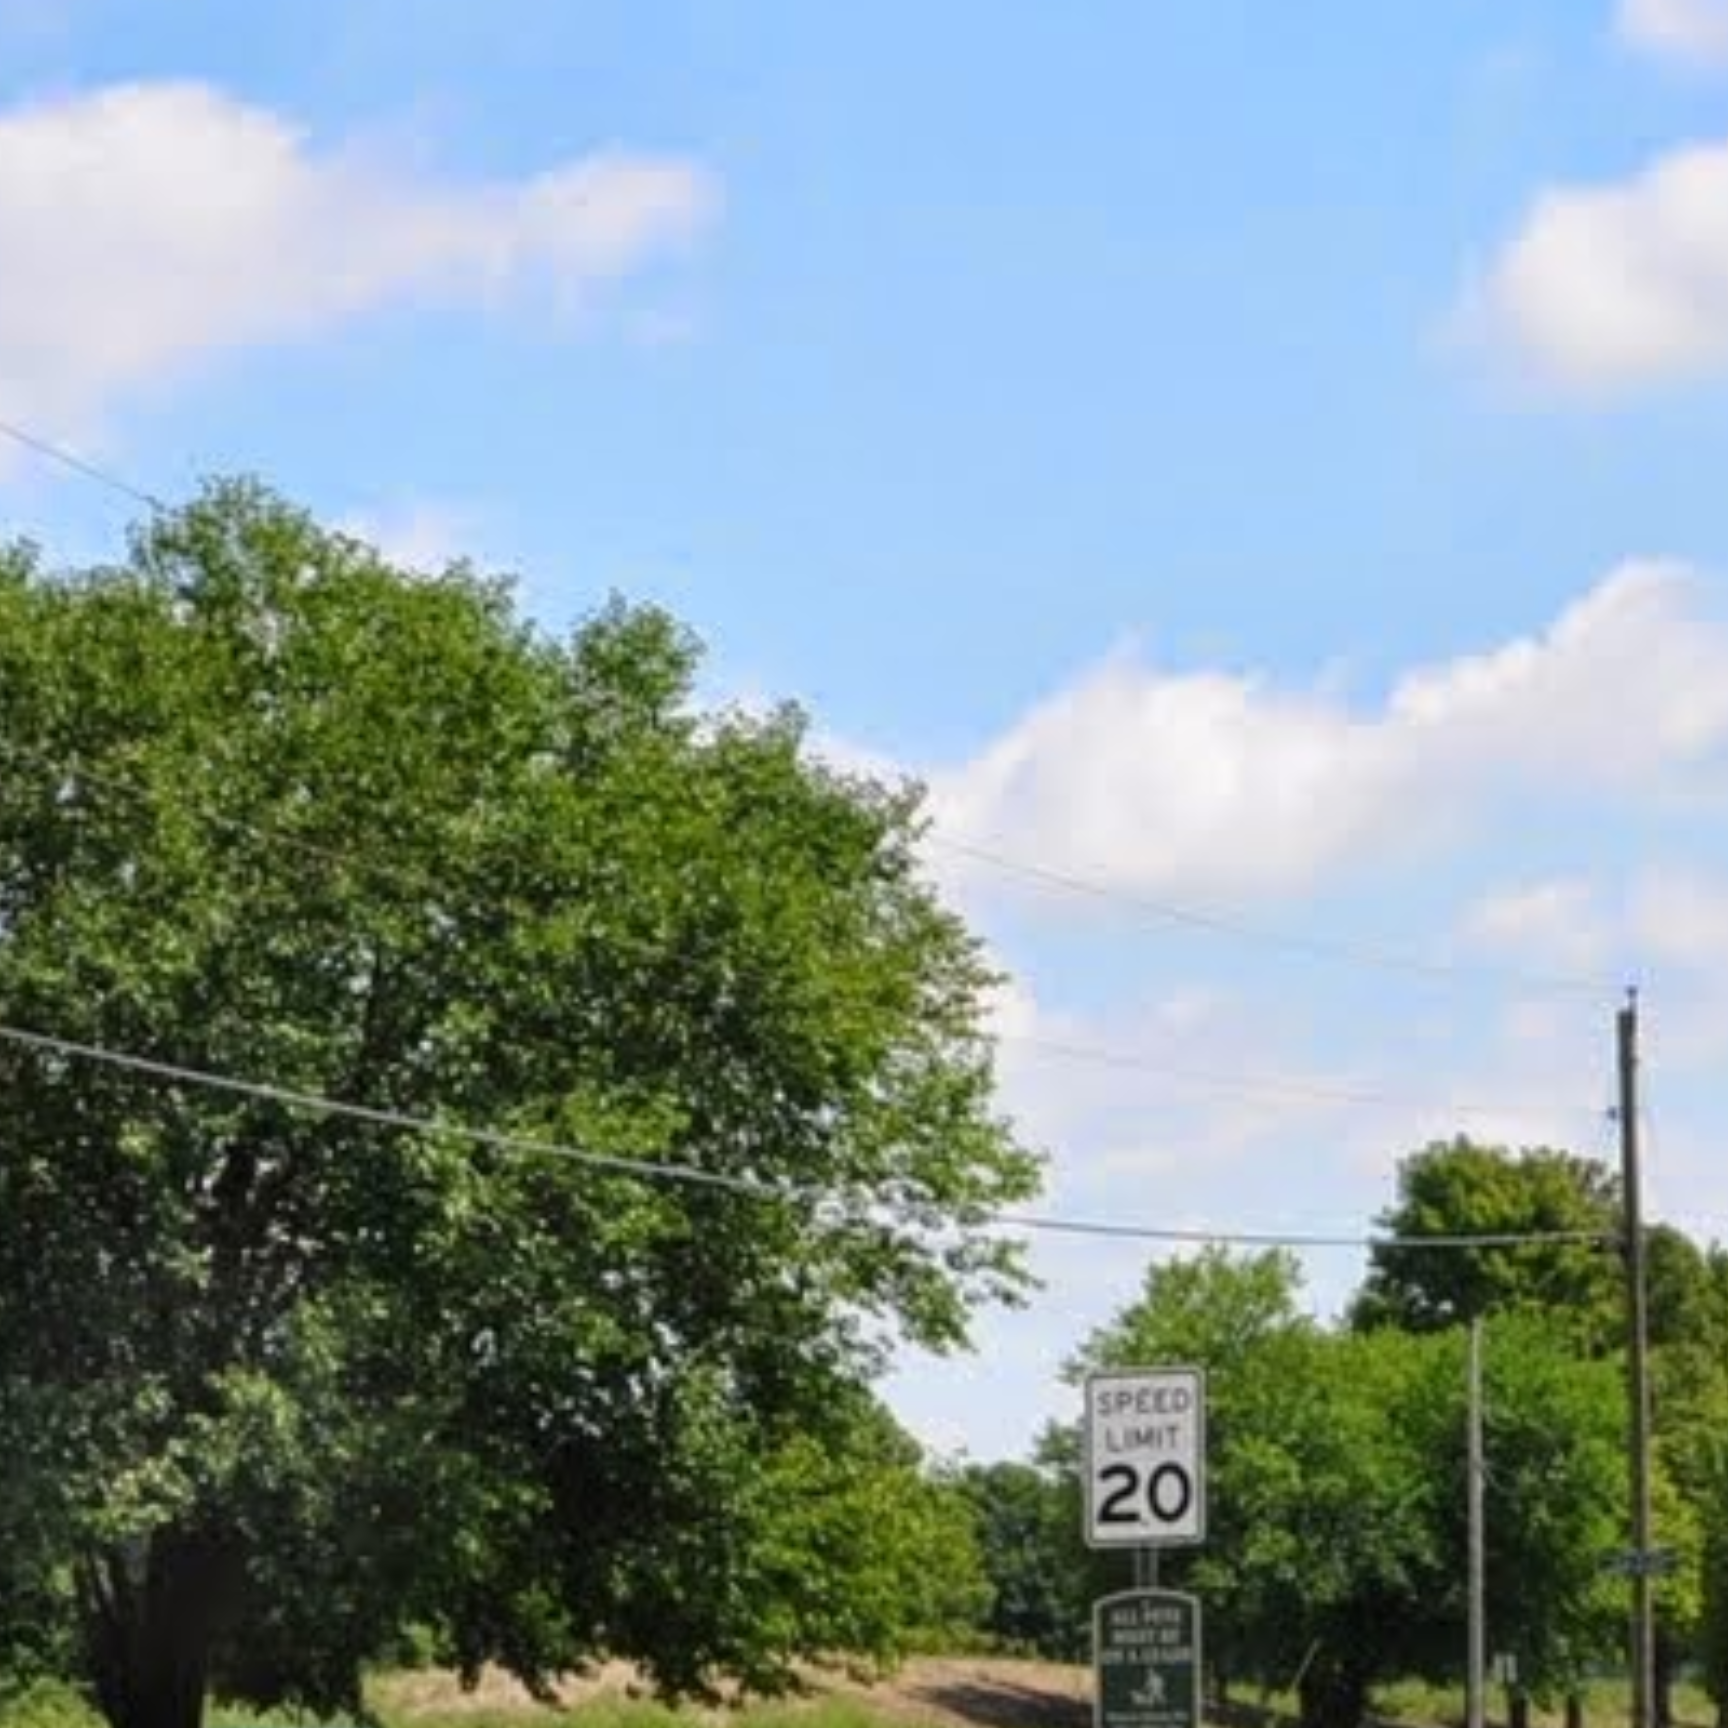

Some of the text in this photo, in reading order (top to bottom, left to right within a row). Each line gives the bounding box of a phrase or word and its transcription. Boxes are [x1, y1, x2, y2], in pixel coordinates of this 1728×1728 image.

[1097, 1386, 1191, 1418] SPEED
[1105, 1424, 1181, 1453] LIMIT
[1096, 1461, 1191, 1523] 20
